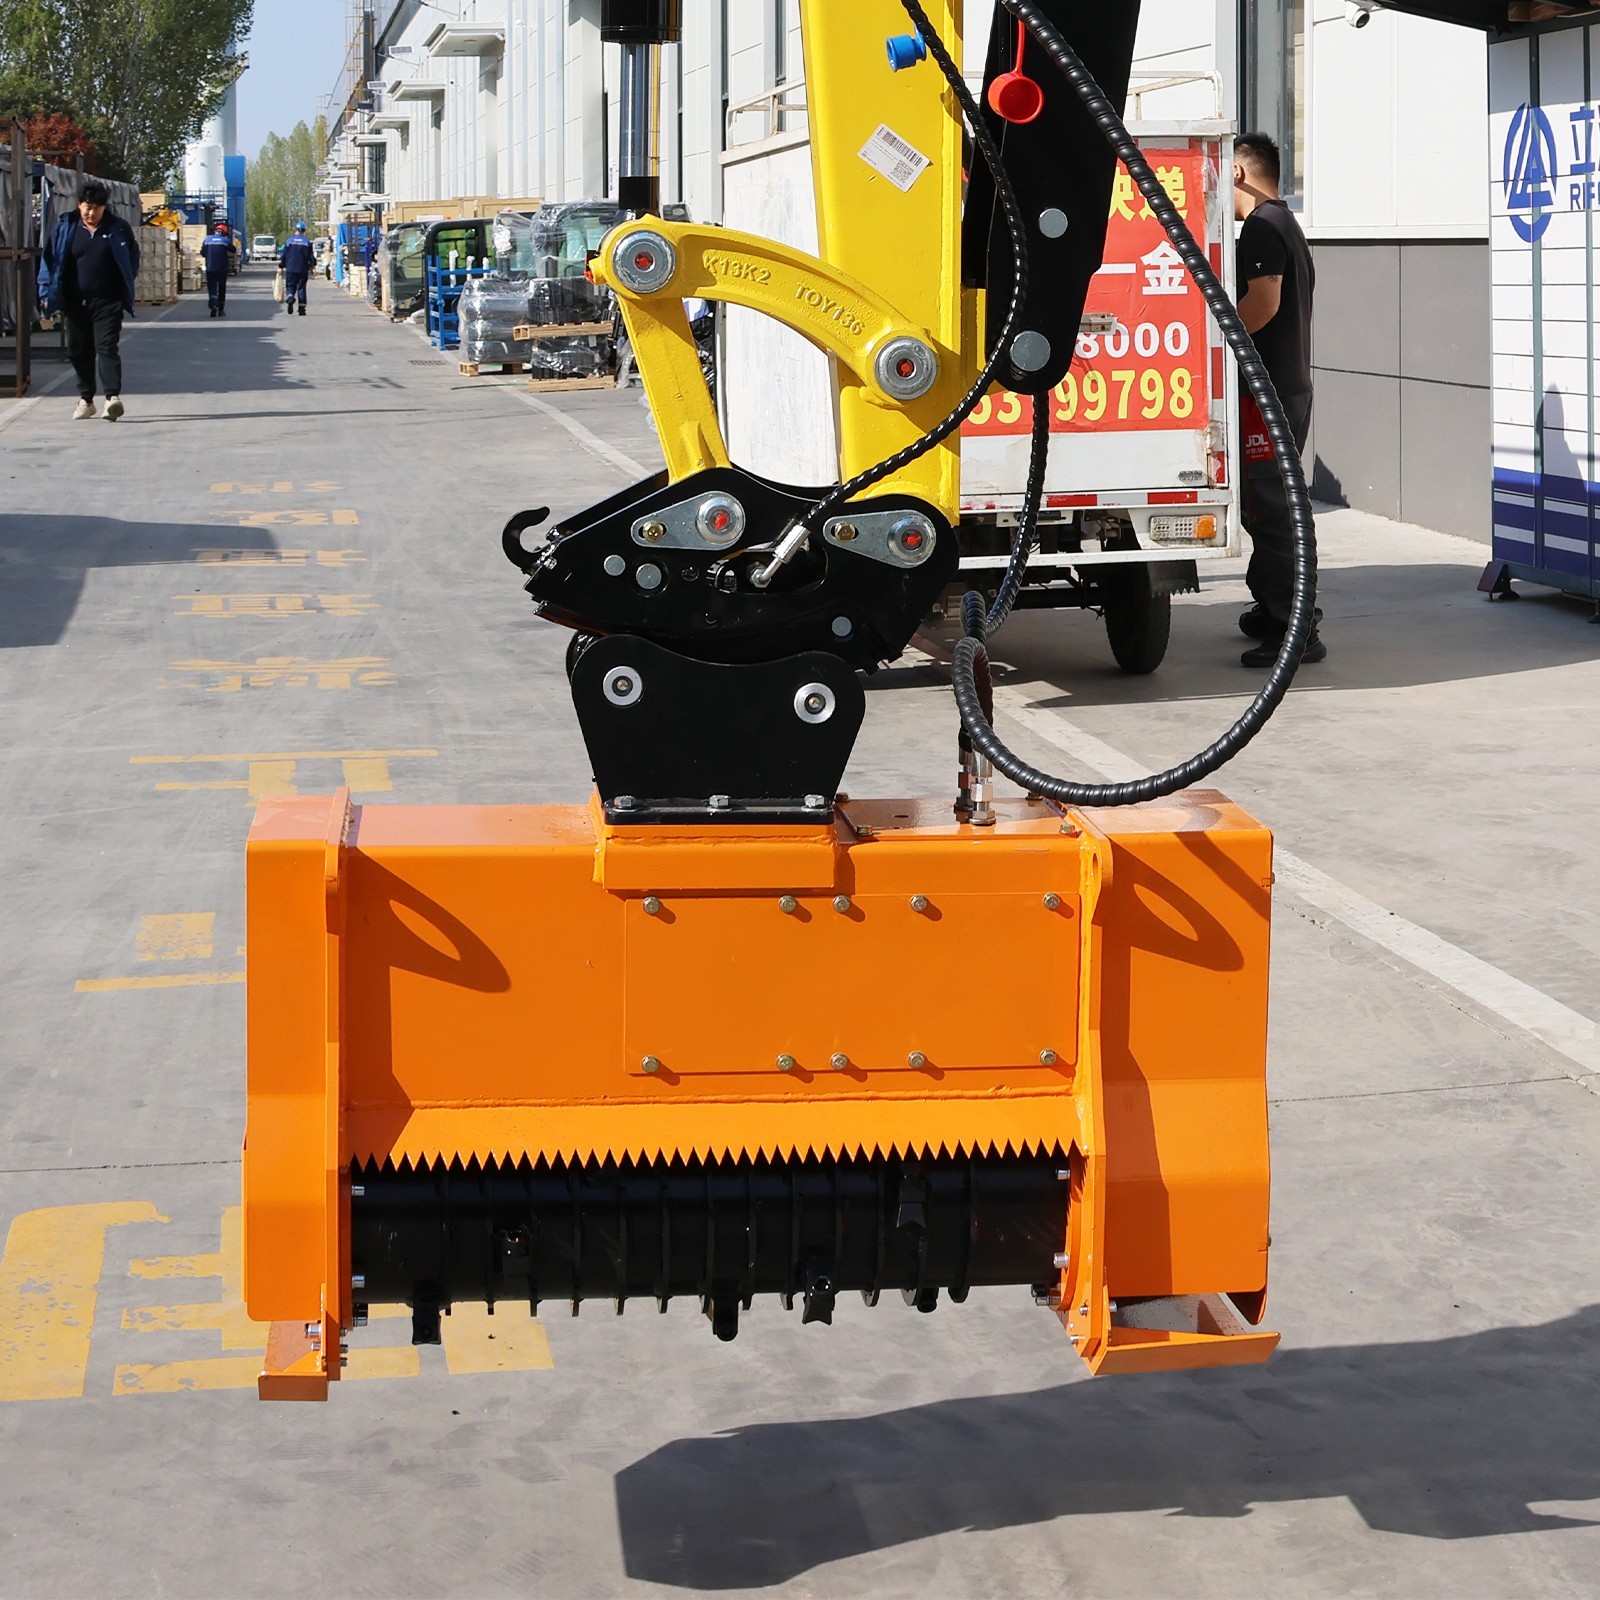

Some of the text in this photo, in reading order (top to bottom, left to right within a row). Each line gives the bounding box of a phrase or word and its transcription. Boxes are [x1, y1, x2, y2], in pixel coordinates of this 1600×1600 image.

[1569, 105, 1600, 175] 立
[1569, 182, 1600, 210] RIF
[702, 254, 866, 336] K13K2 TOY136
[1245, 433, 1269, 448] JDL
